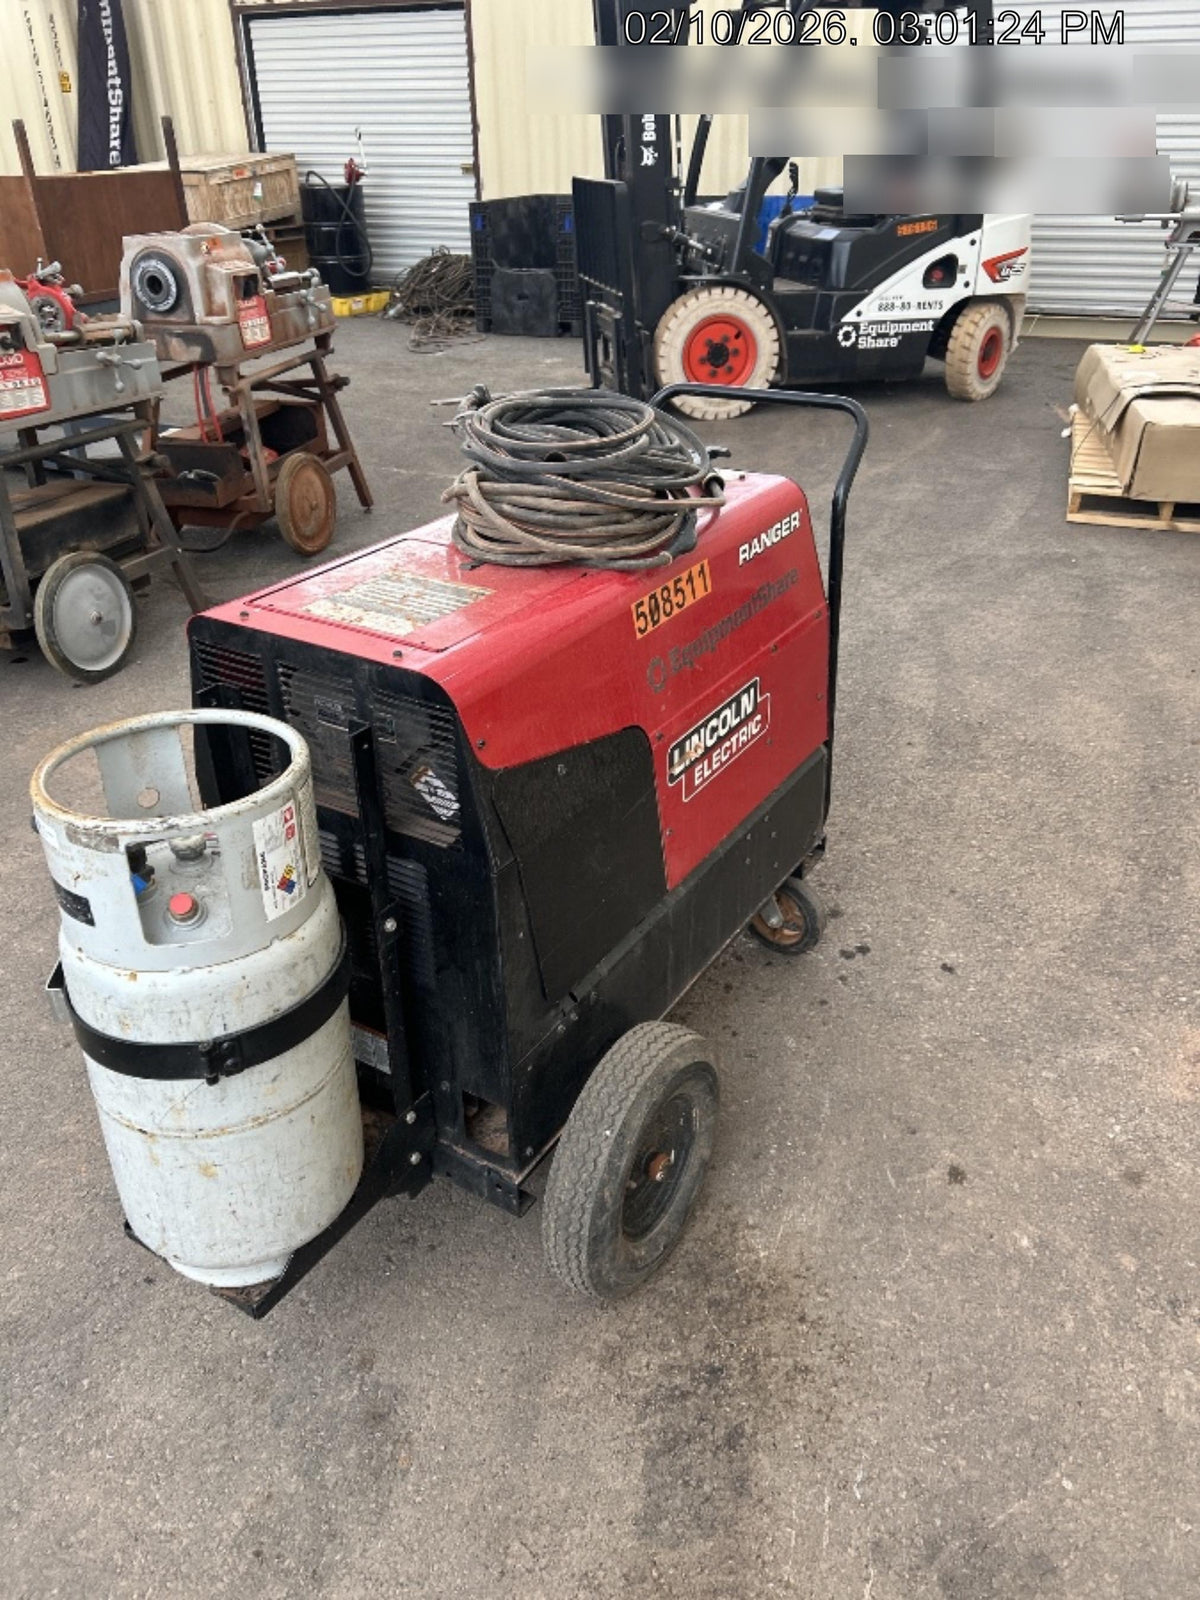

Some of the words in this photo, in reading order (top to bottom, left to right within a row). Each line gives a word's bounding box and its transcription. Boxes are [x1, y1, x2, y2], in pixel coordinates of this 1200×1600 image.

[858, 336, 899, 349] Share
[859, 320, 934, 337] Equipment
[738, 511, 801, 567] RANGER
[634, 562, 710, 636] 508511
[668, 567, 799, 676] EquipmentShare
[673, 687, 755, 776] LINCOLN
[694, 714, 762, 787] ELECTRIC
